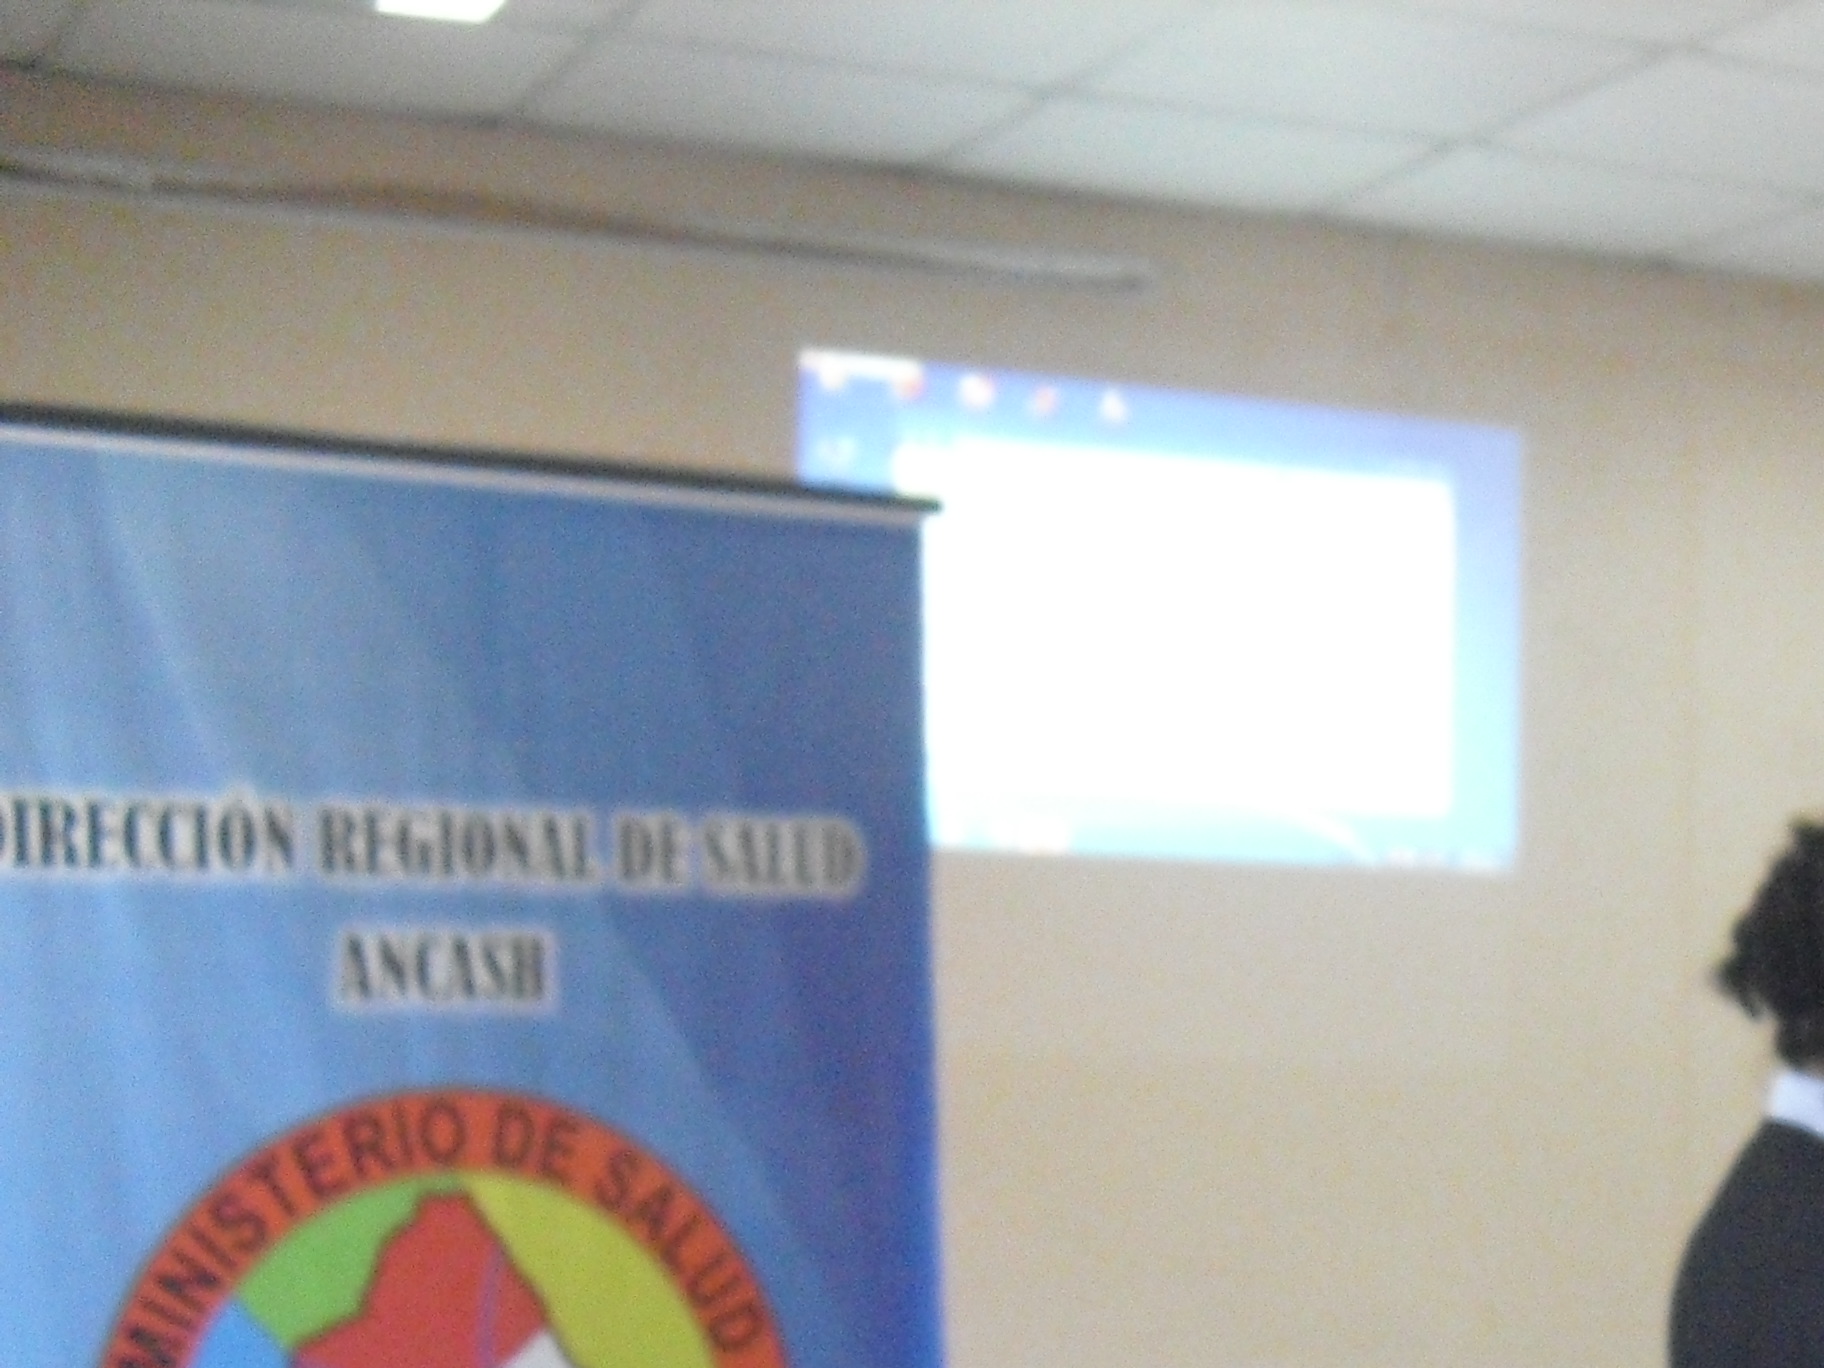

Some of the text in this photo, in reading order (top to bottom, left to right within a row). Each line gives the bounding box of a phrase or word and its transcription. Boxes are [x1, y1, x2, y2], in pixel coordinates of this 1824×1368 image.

[0, 782, 864, 894] IRECCIÓN REGIONAL DE SALUD
[346, 932, 546, 1004] ANCASH
[495, 1102, 580, 1184] DE
[596, 1150, 764, 1352] SALUD
